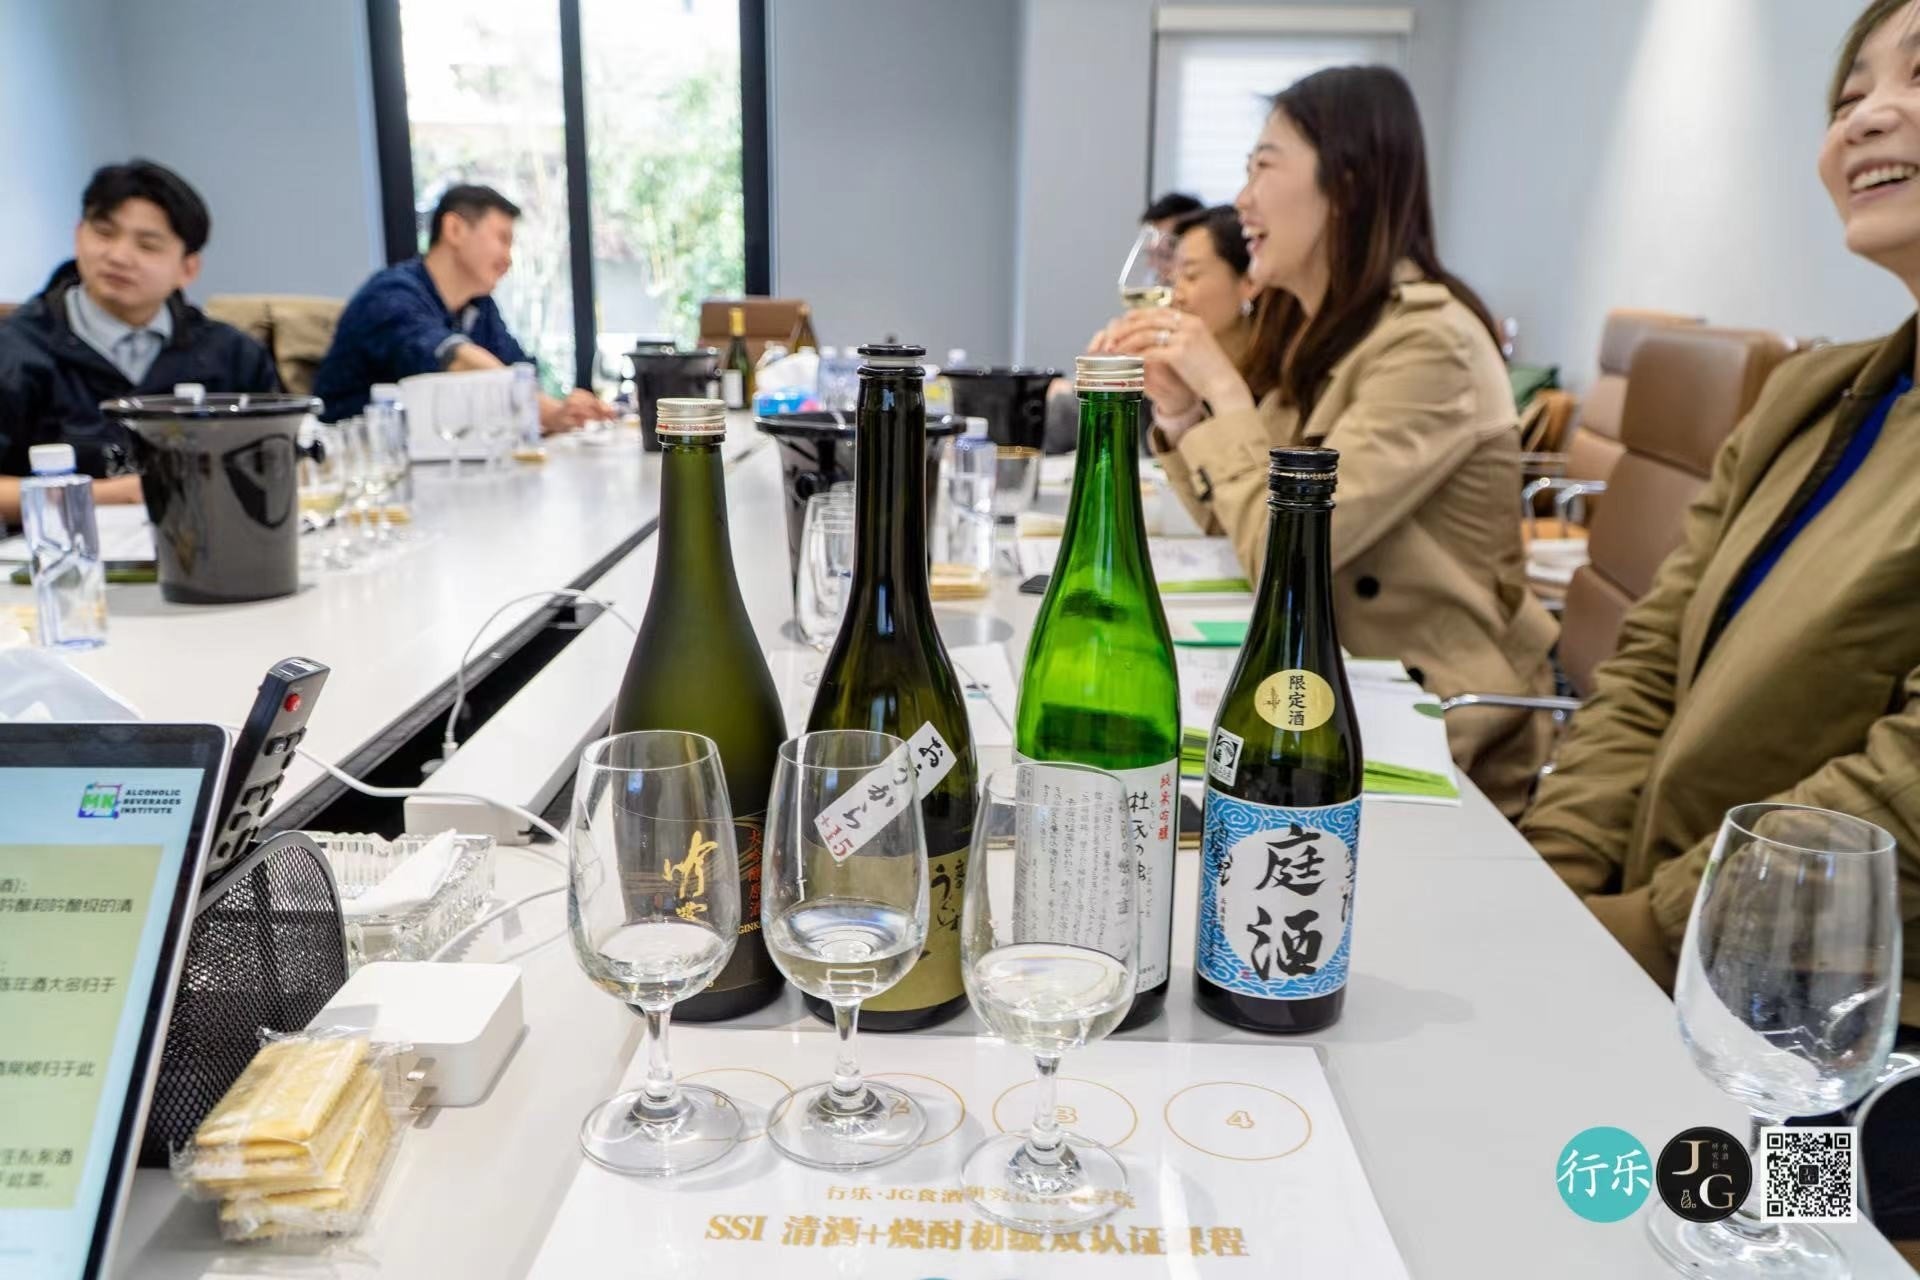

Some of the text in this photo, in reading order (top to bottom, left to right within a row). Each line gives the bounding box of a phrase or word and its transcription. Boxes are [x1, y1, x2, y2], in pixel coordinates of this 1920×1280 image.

[1288, 675, 1306, 727] 限定酒
[122, 798, 181, 806] BEVERAGES
[125, 789, 181, 797] ALCOHOLIC
[120, 807, 173, 815] INSTITUTE
[1246, 822, 1326, 981] 庭酒
[1226, 1110, 1254, 1129] 4
[704, 1215, 768, 1241] SSI
